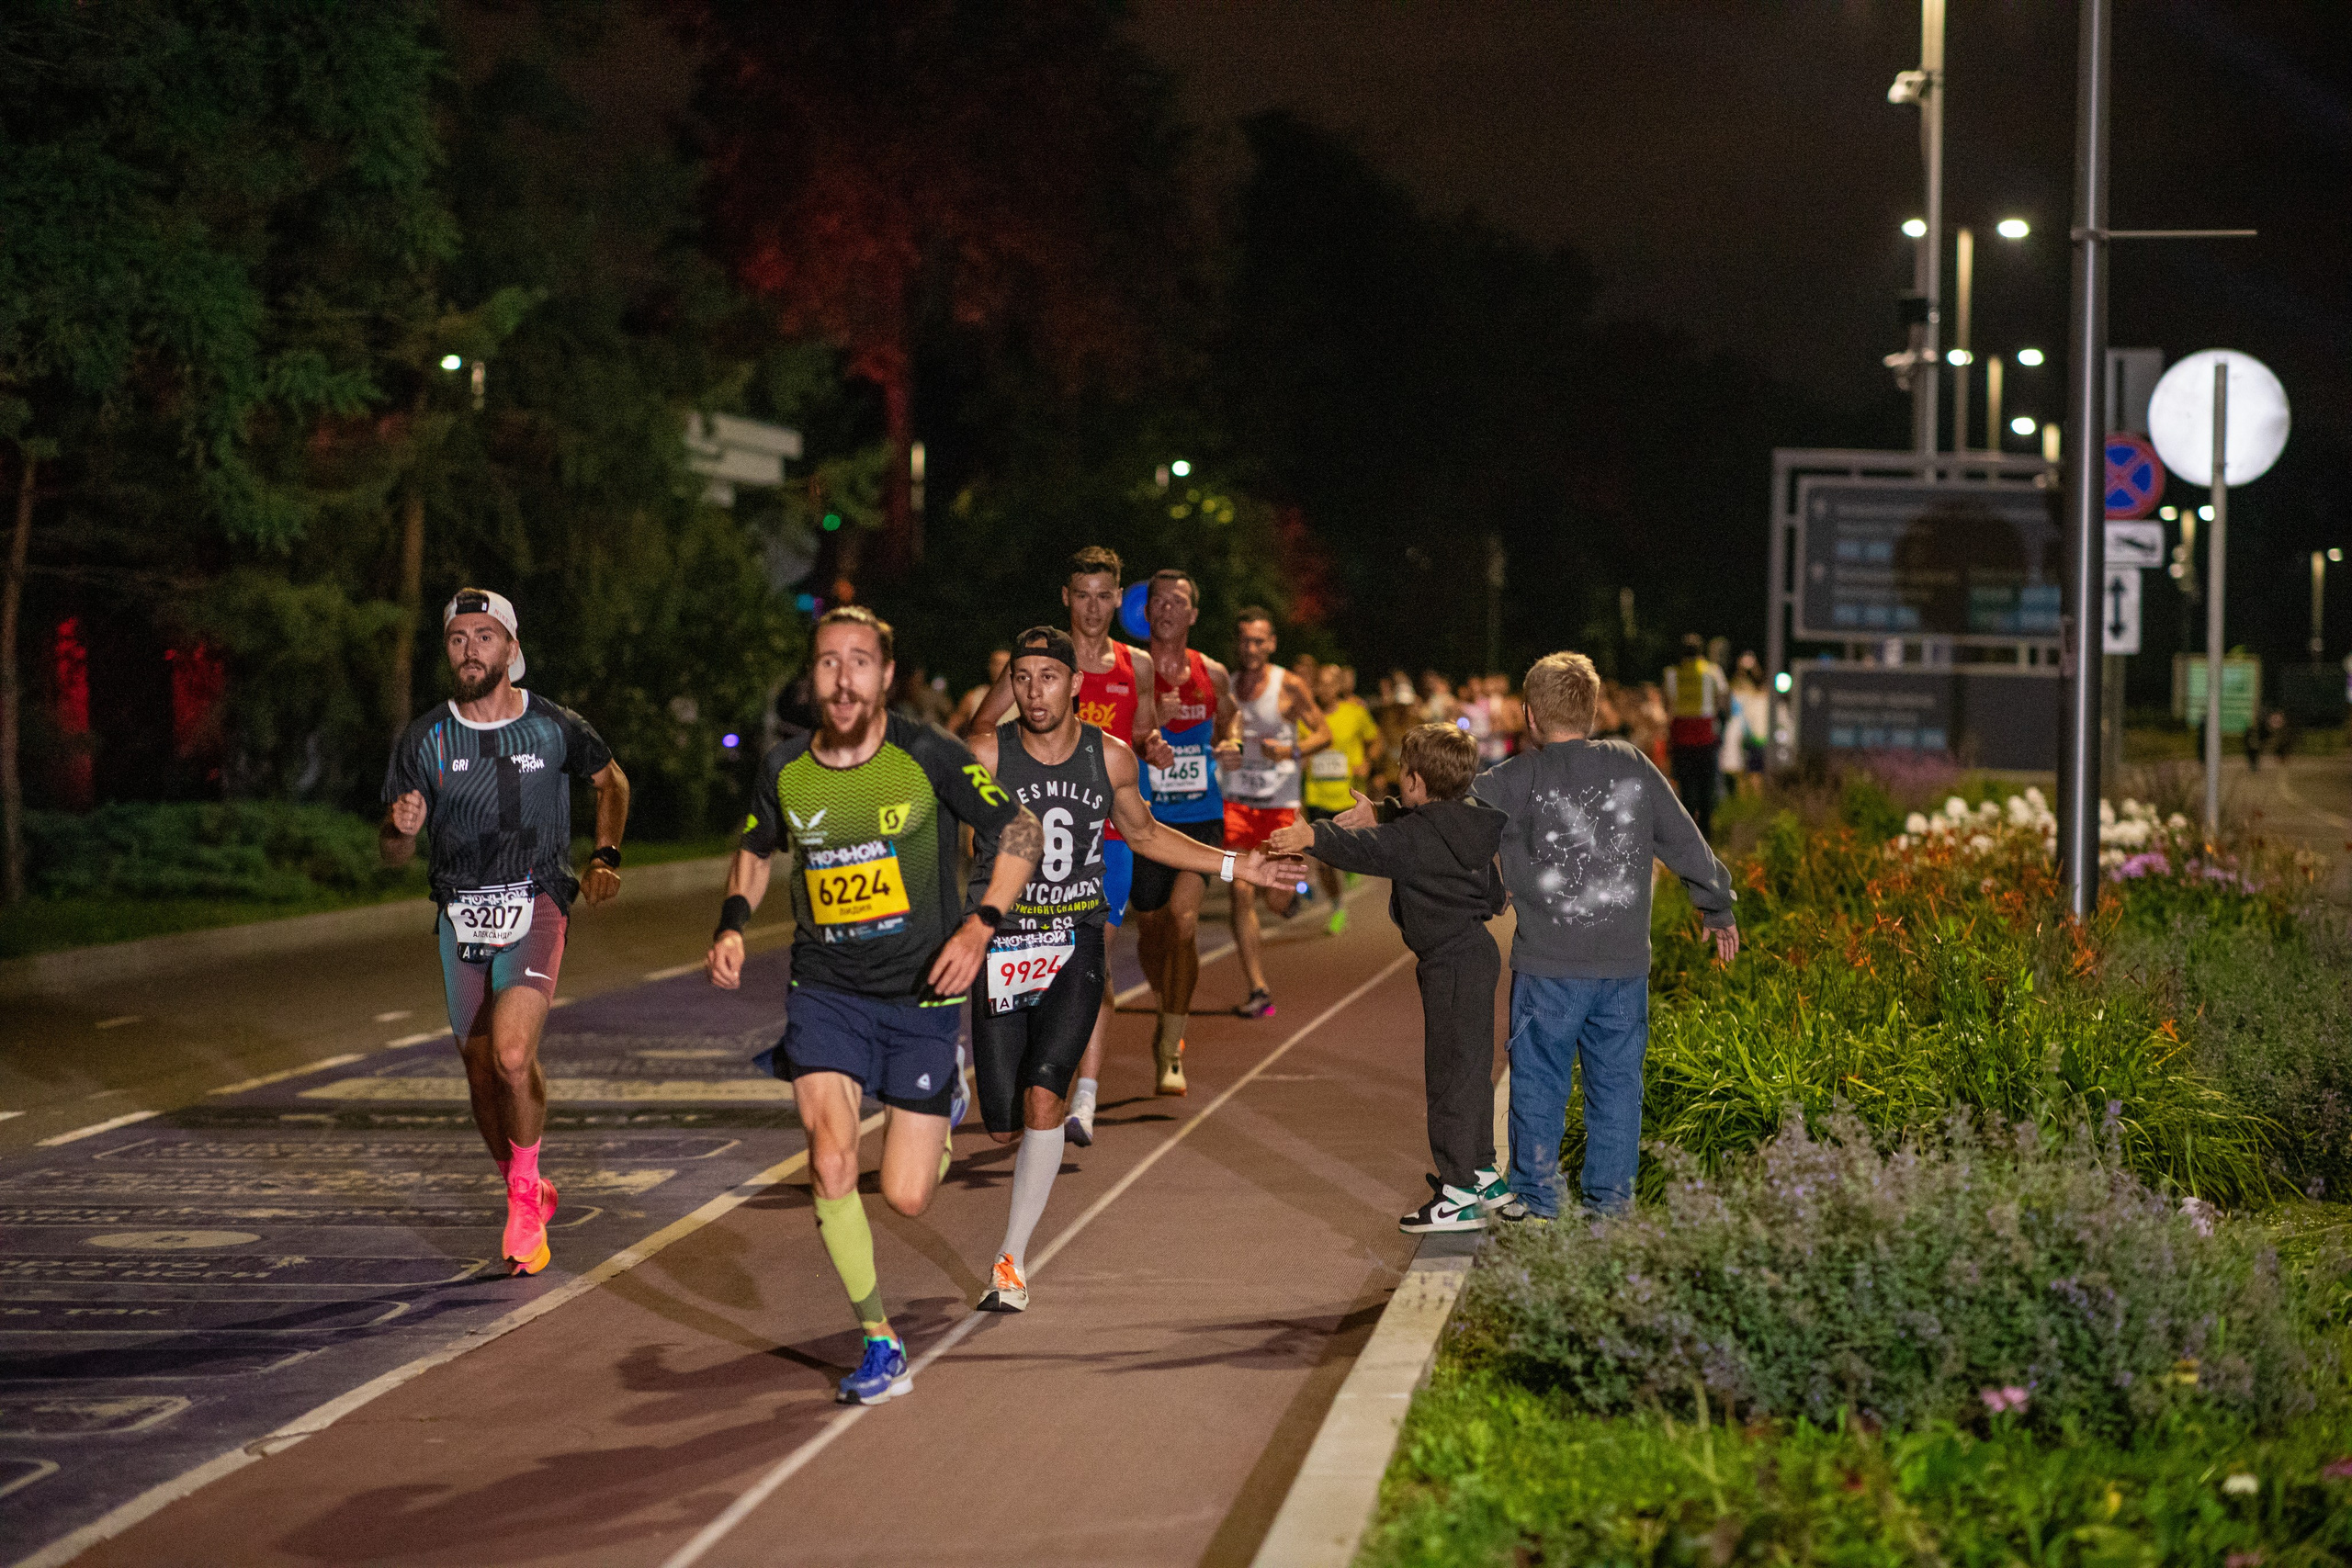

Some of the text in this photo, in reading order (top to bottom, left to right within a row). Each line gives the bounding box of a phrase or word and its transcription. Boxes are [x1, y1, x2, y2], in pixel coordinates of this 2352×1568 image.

[962, 764, 1010, 807] RC
[1016, 781, 1103, 809] ES MILLS
[820, 869, 891, 906] 6224
[460, 906, 523, 930] 3207
[472, 931, 513, 940] АЛЕКСАНДР
[462, 945, 470, 959] A
[1001, 954, 1062, 987] 9924
[1000, 997, 1010, 1010] A
